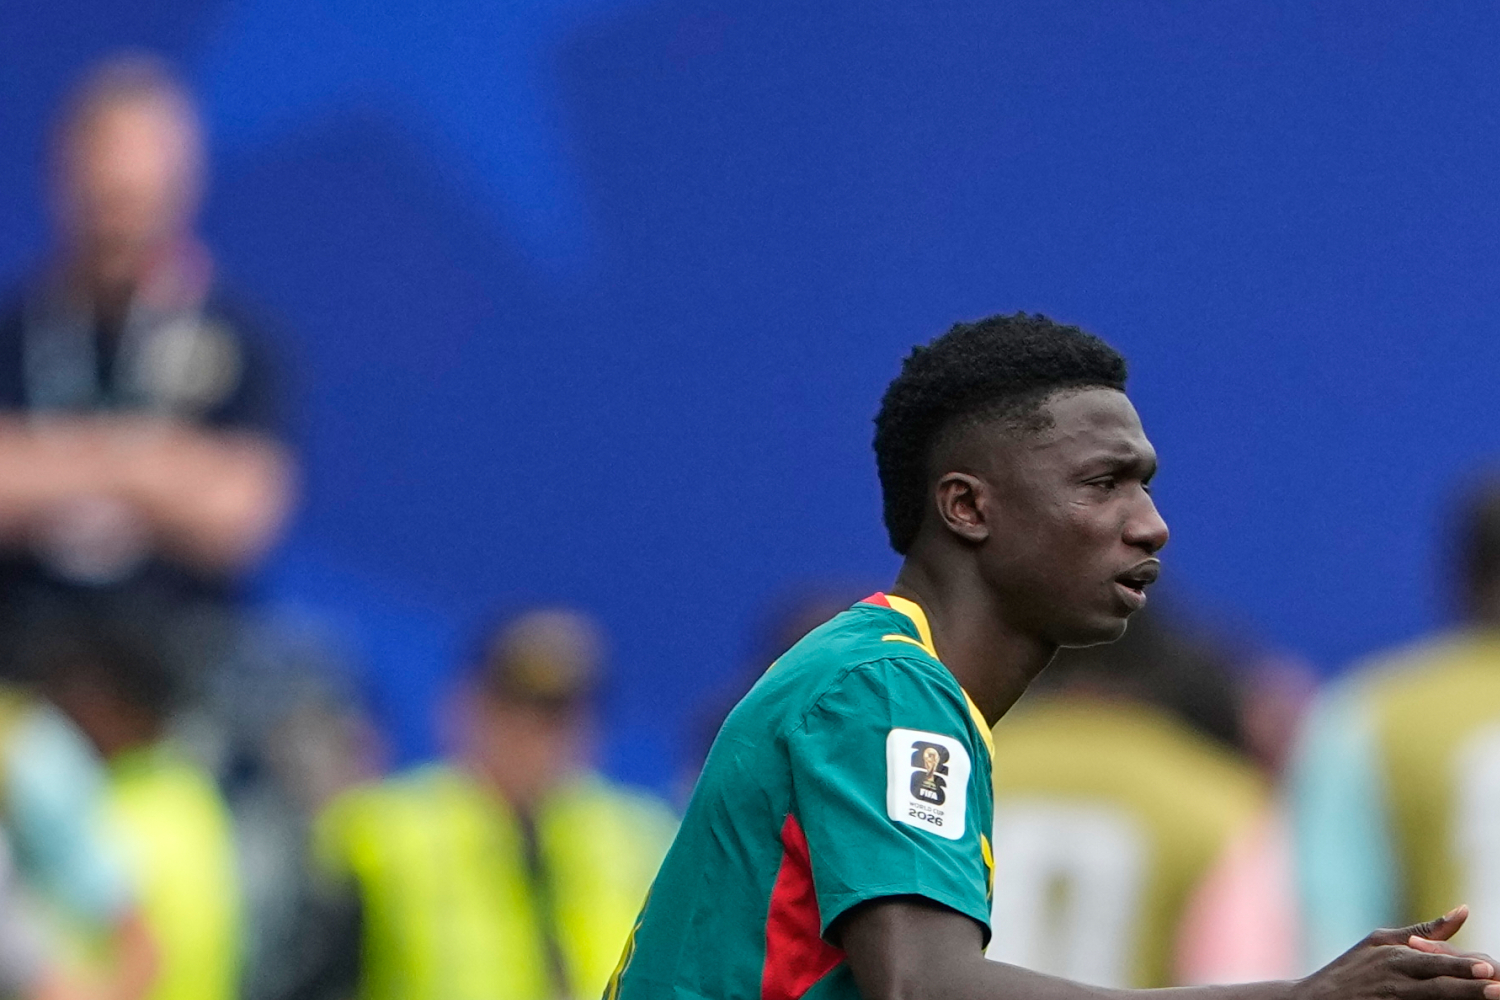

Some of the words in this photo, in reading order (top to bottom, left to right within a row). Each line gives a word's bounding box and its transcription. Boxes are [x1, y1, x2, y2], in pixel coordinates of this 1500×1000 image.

[919, 787, 939, 800] FIFA
[909, 801, 933, 812] WORLD
[933, 808, 945, 816] CUP
[908, 807, 943, 827] 2026
